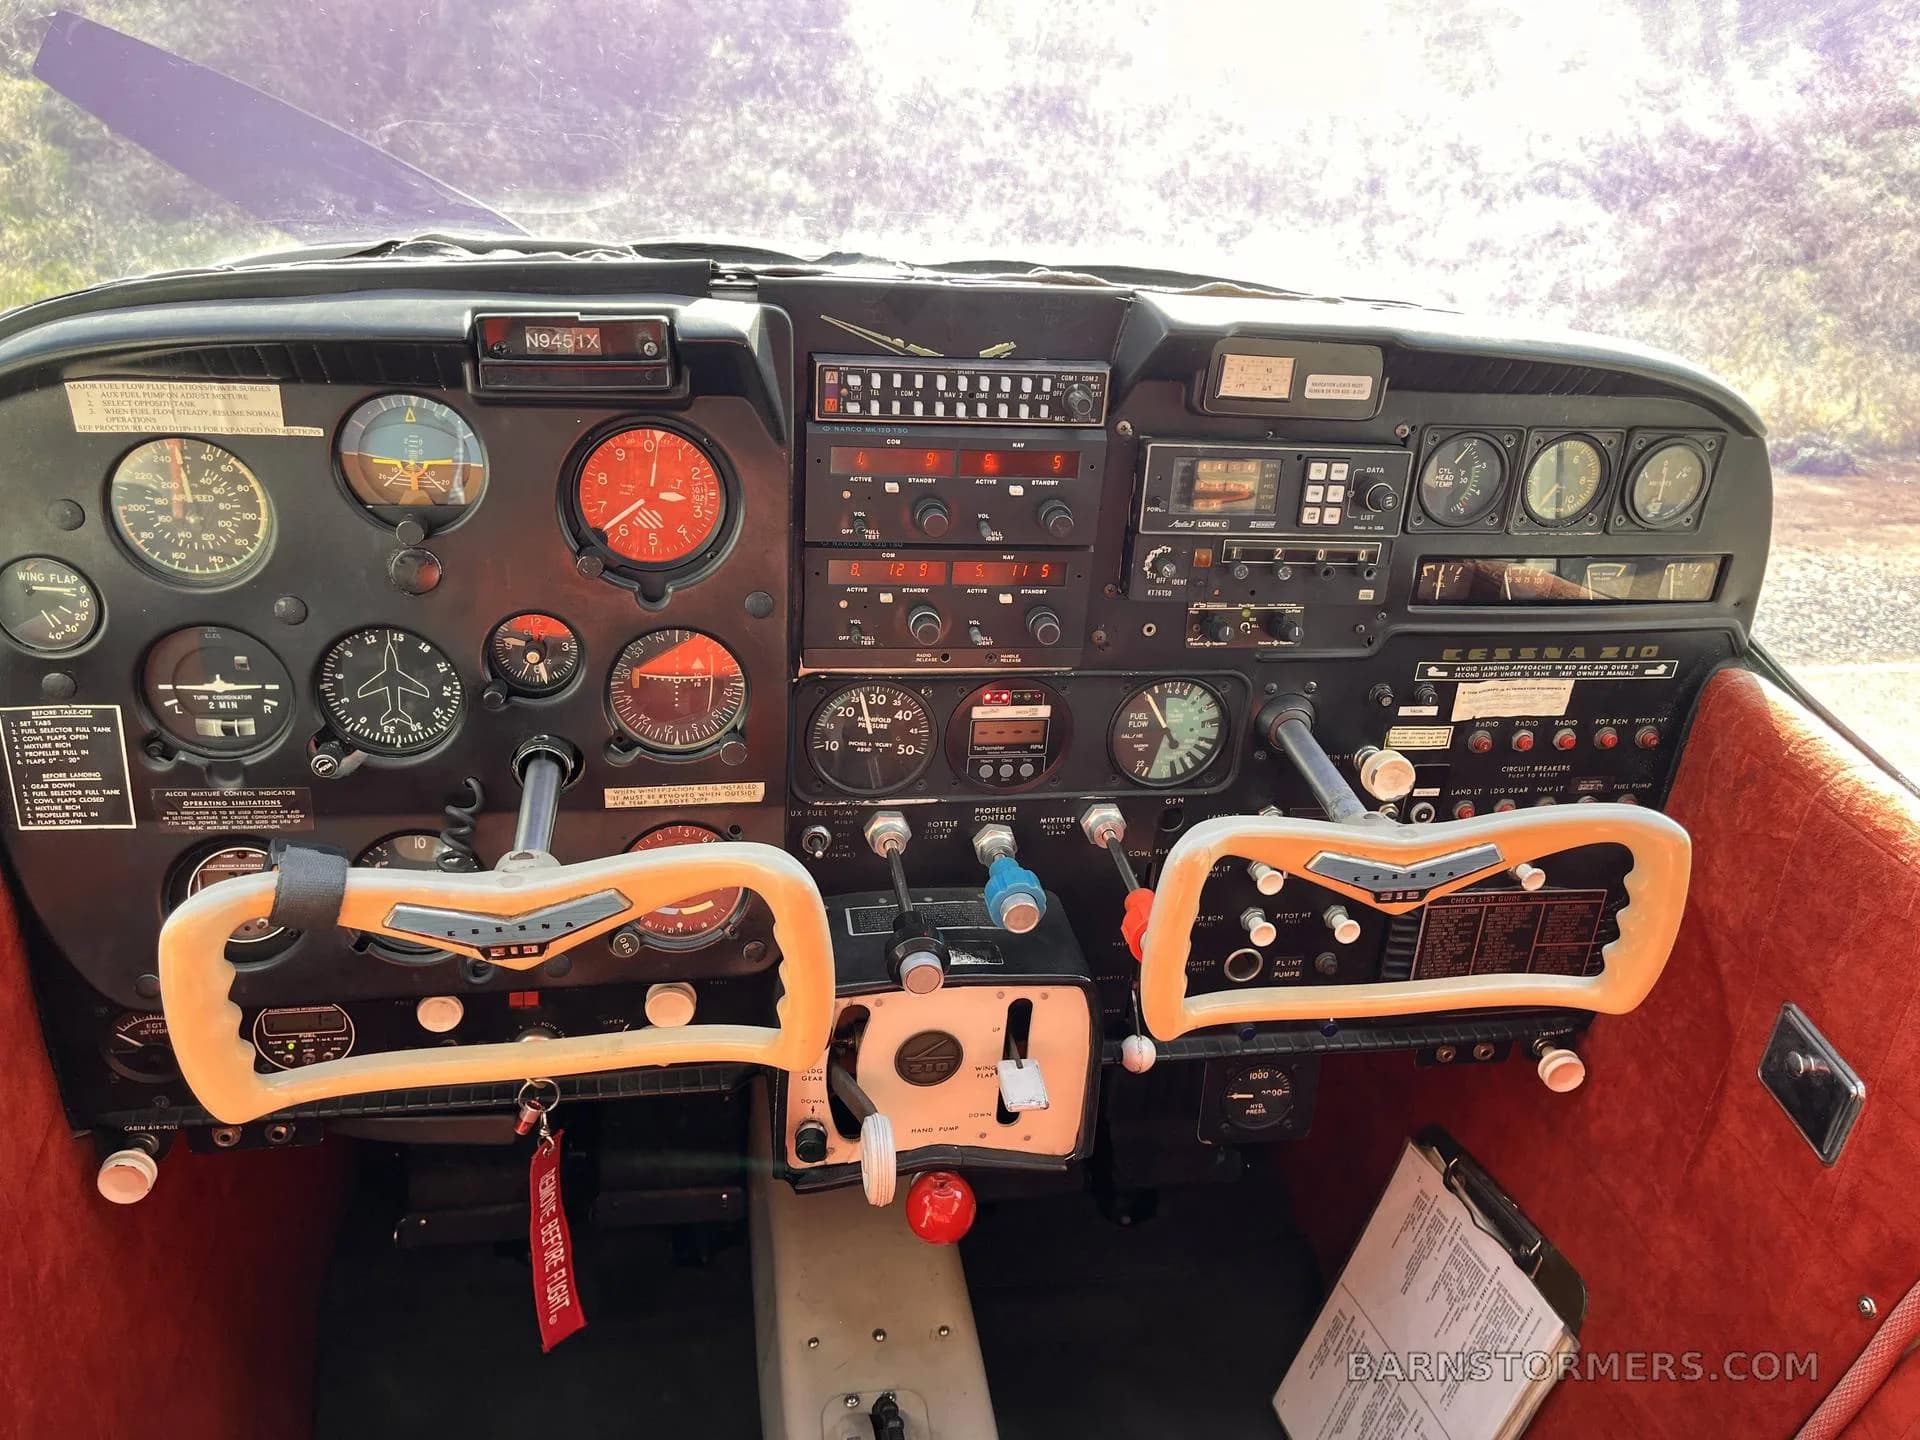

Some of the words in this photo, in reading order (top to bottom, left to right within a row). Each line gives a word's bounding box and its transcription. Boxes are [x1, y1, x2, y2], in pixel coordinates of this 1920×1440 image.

[526, 331, 599, 349] N9451X
[616, 448, 625, 461] 9
[597, 472, 608, 485] 8
[691, 467, 700, 480] 2
[649, 533, 658, 545] 5
[17, 572, 45, 581] WING
[50, 574, 78, 584] FLAP
[75, 611, 88, 620] 20°
[65, 623, 79, 632] 30°
[364, 635, 377, 644] 12
[393, 633, 404, 642] 15
[418, 642, 431, 653] 18
[562, 642, 569, 651] 3
[632, 647, 644, 658] 33
[1443, 647, 1586, 660] CESSNA
[1600, 645, 1660, 658] 210
[621, 668, 631, 680] 30
[869, 695, 886, 704] 30
[175, 705, 183, 714] L
[264, 705, 272, 713] R
[837, 707, 855, 717] 20
[894, 711, 912, 720] 40
[825, 741, 839, 751] 10
[897, 745, 914, 755] 50
[1040, 816, 1075, 824] MIXTURE
[414, 836, 426, 849] 10
[1354, 872, 1454, 881] CESSNA
[447, 922, 574, 937] CESSNA
[620, 937, 632, 954] OBS
[910, 1062, 949, 1073] 210
[1250, 1072, 1268, 1080] 1000
[539, 1167, 556, 1223] REMOVE
[541, 1218, 564, 1273] BEFORE
[547, 1267, 569, 1315] FLIGHT
